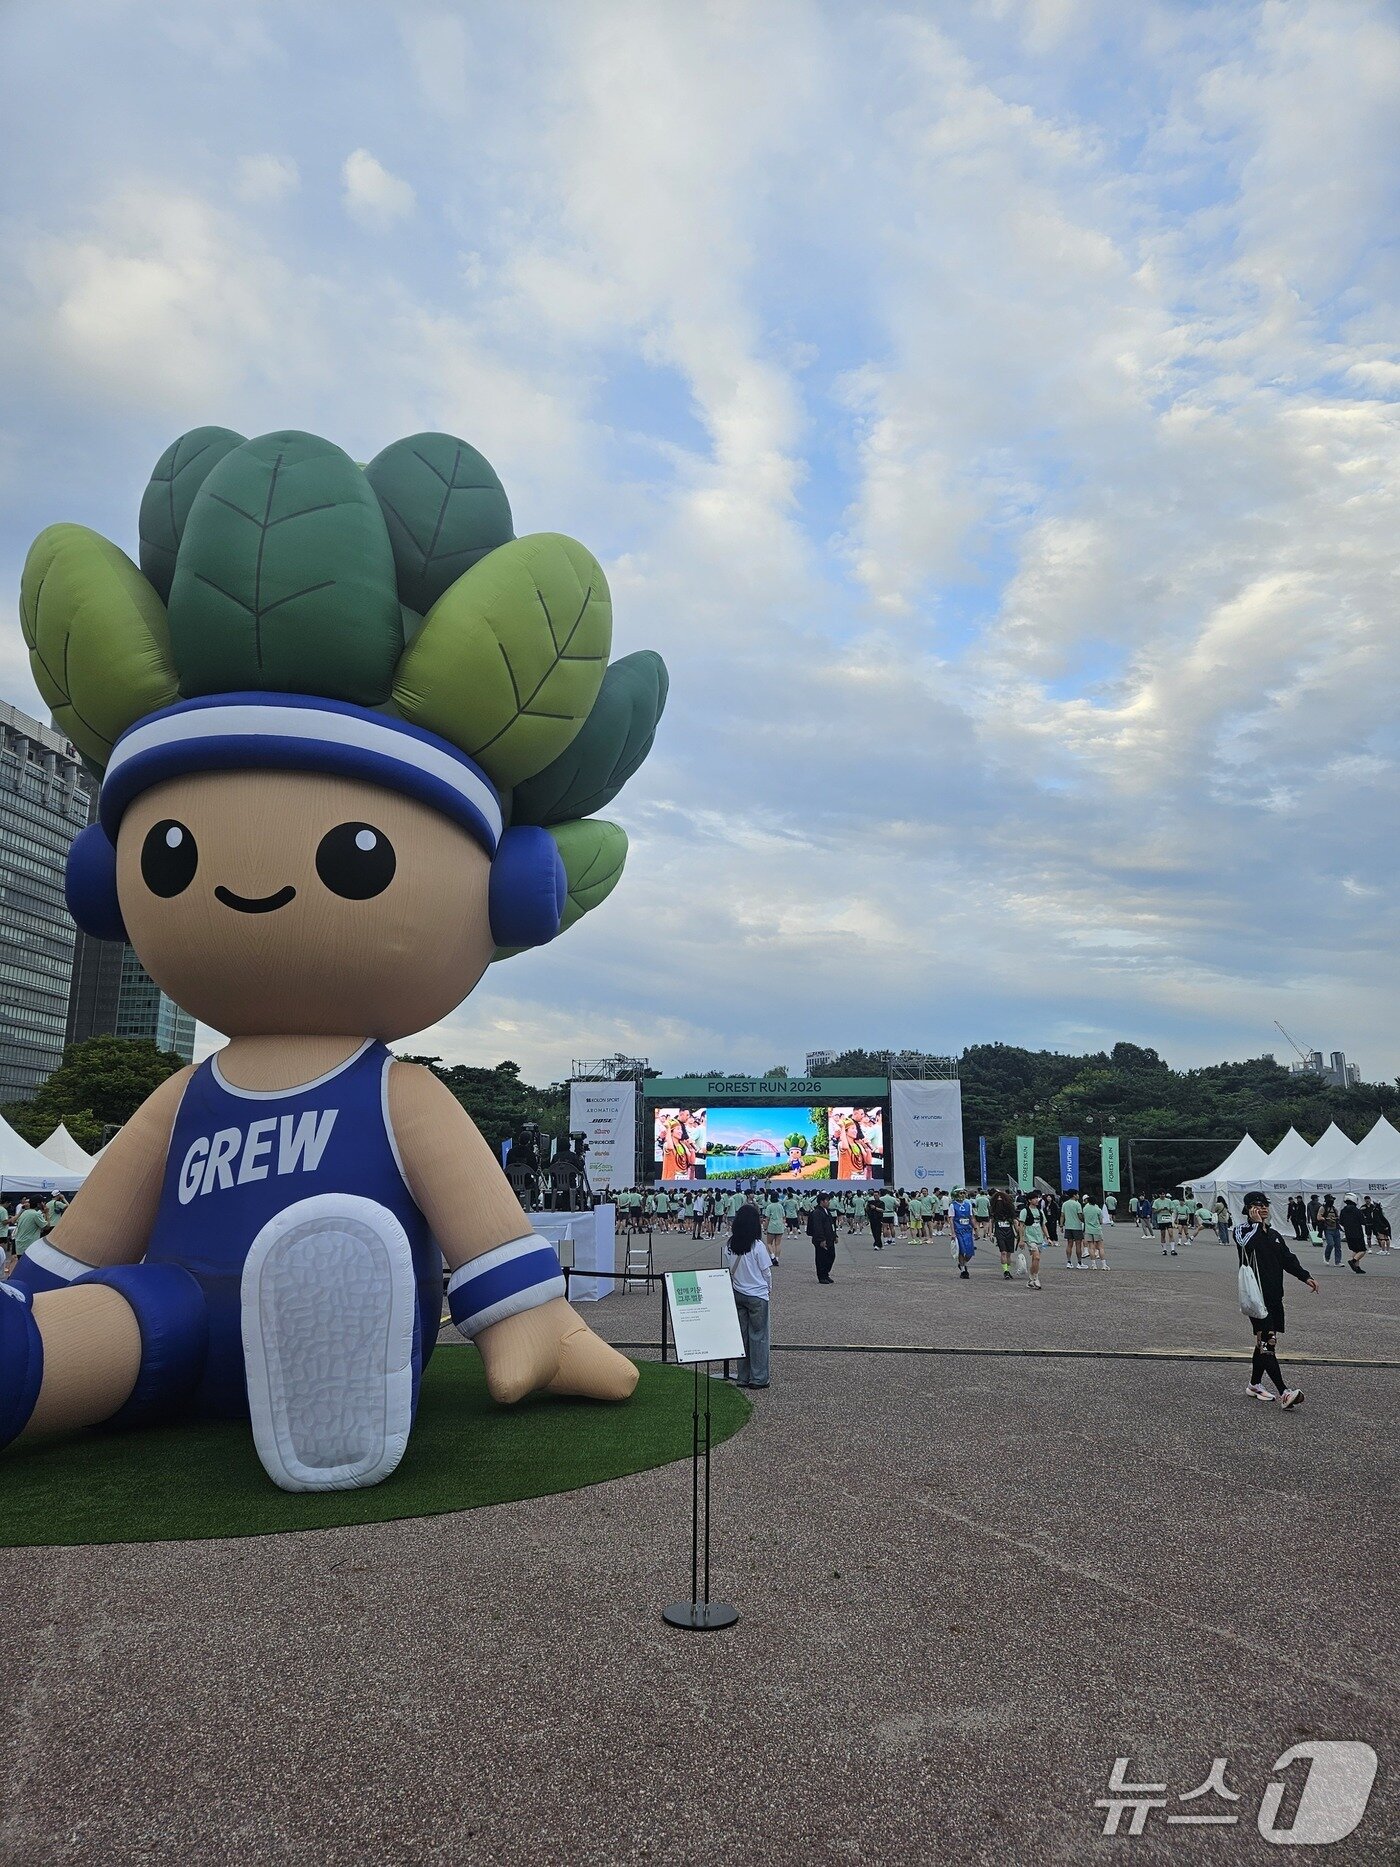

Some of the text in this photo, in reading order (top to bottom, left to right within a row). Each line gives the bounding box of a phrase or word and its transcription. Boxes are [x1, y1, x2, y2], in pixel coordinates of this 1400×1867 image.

[708, 1081, 822, 1093] FOREST RUN 2026
[178, 1109, 339, 1205] GREW
